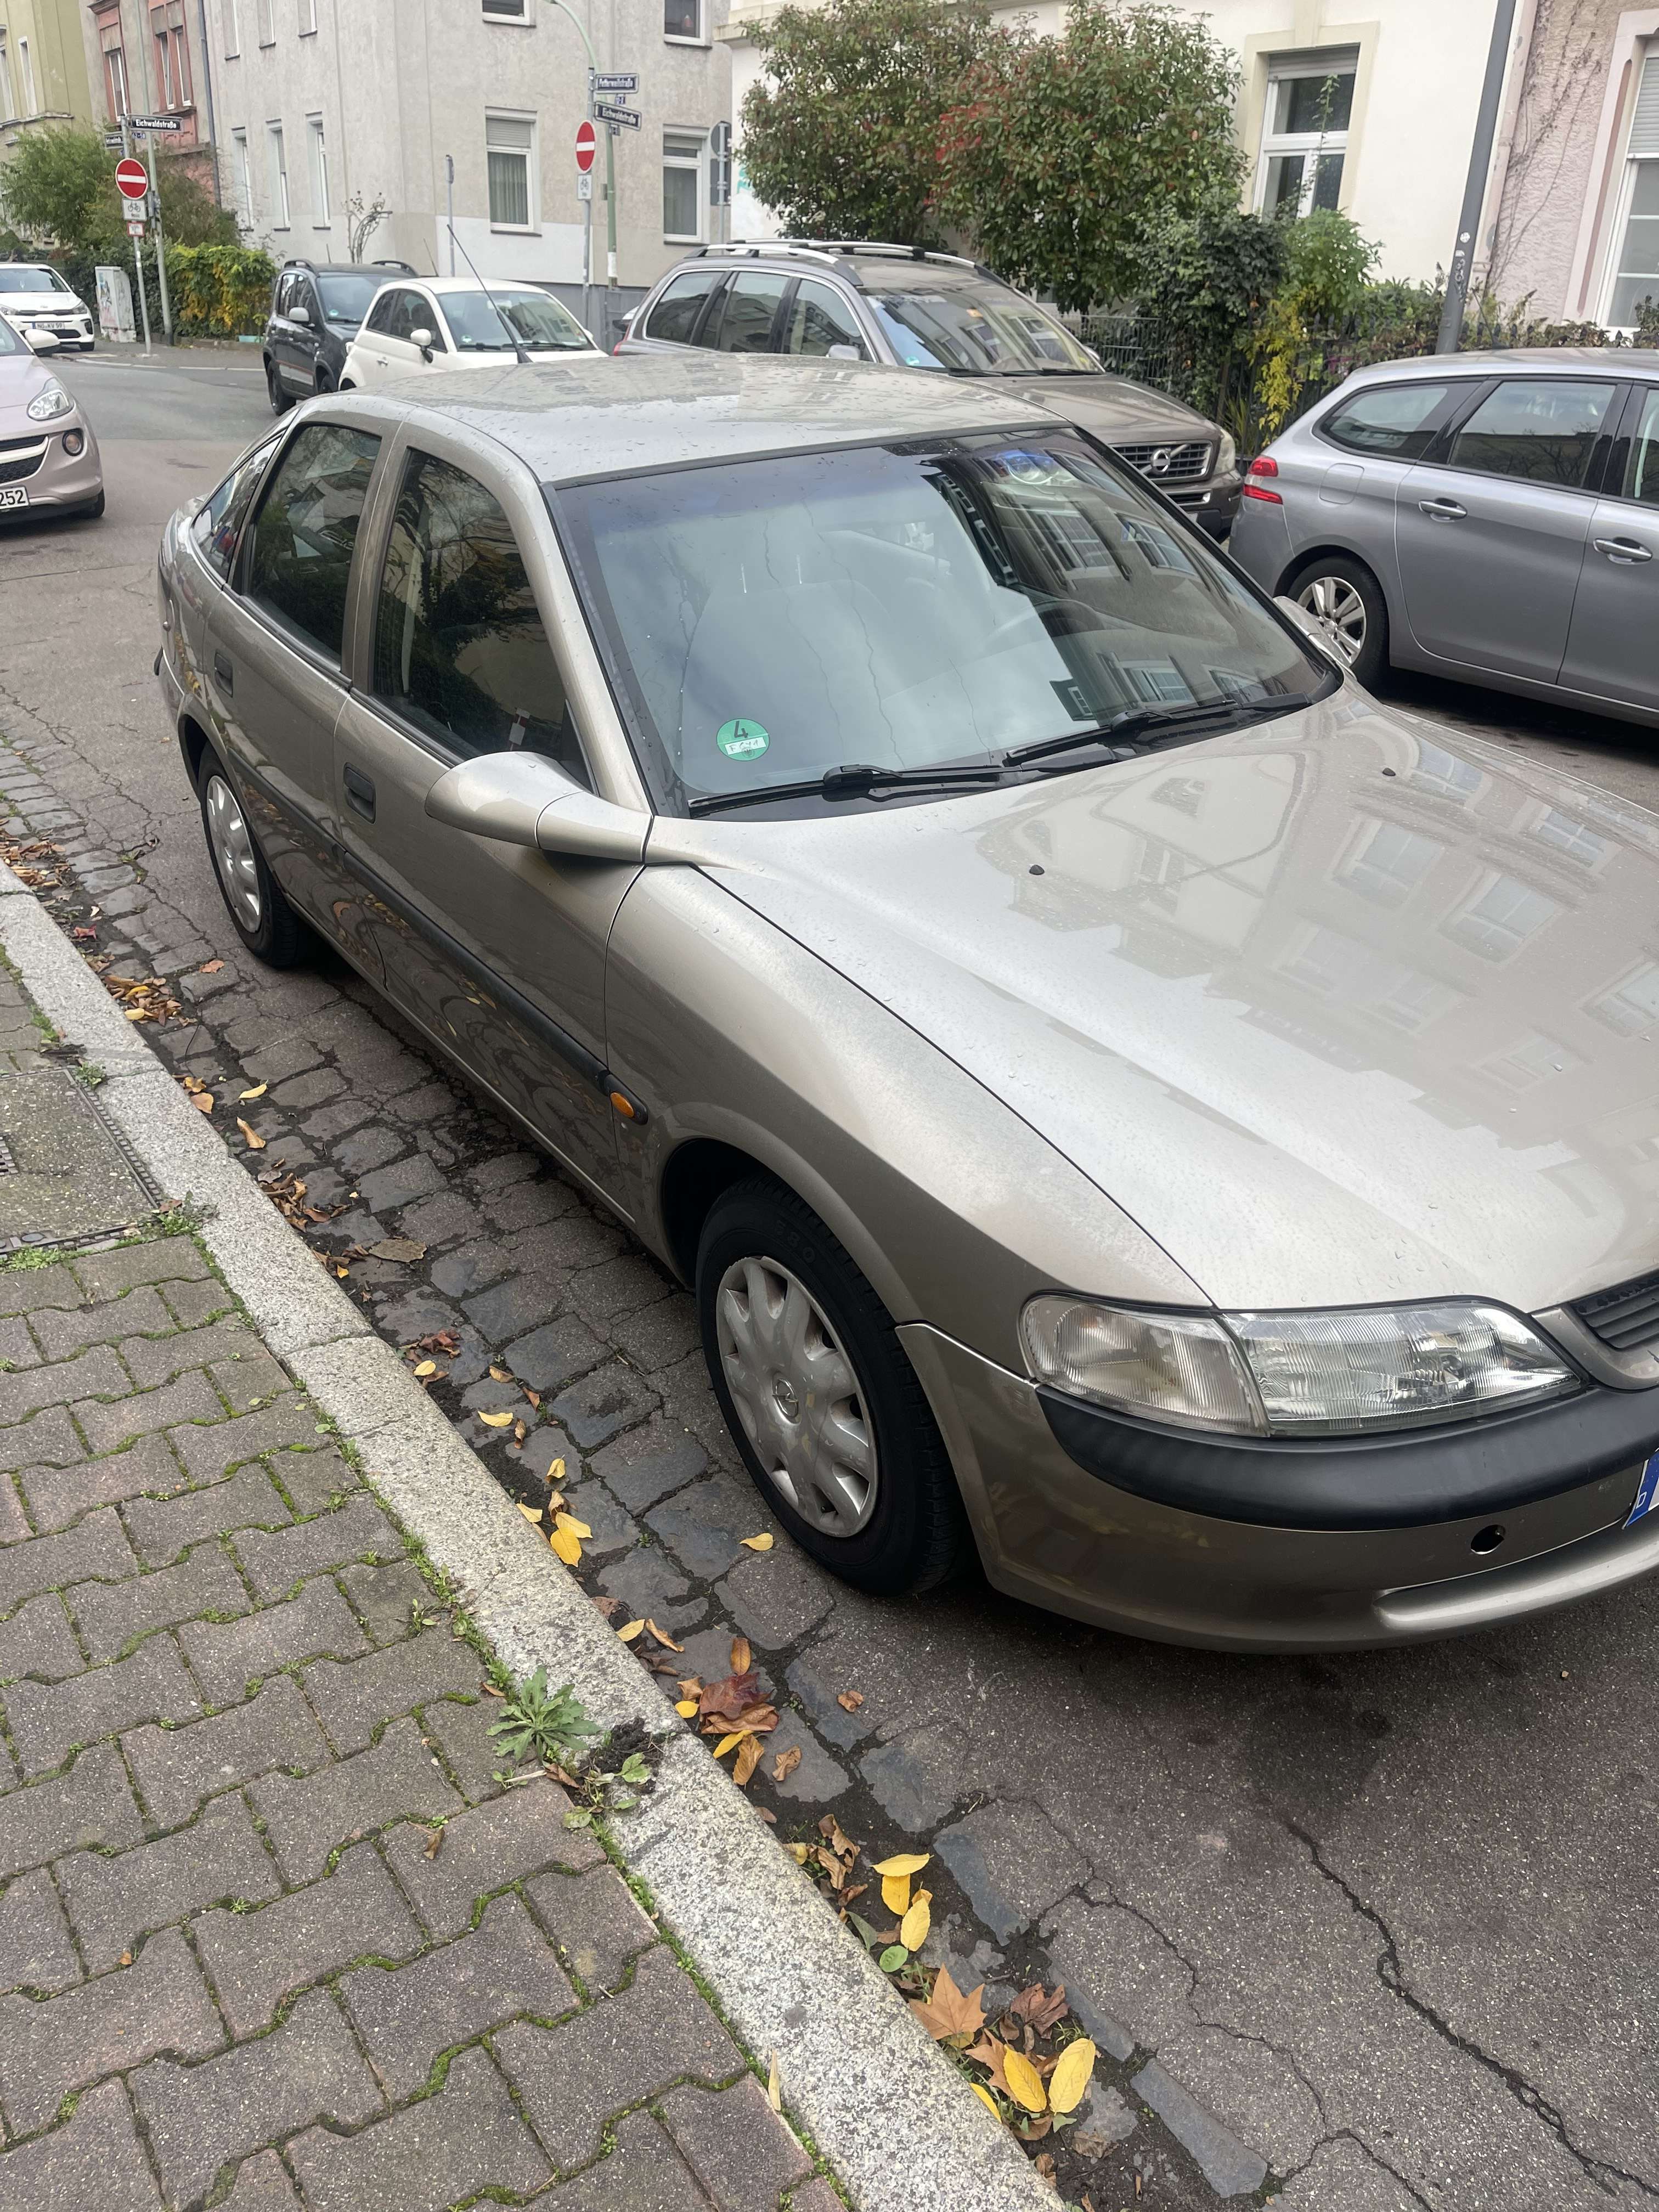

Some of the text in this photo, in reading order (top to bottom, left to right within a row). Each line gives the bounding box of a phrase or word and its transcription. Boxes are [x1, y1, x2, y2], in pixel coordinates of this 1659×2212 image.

[136, 119, 176, 128] Eichwaldstraße
[734, 720, 748, 738] 4
[1635, 1491, 1647, 1510] D
